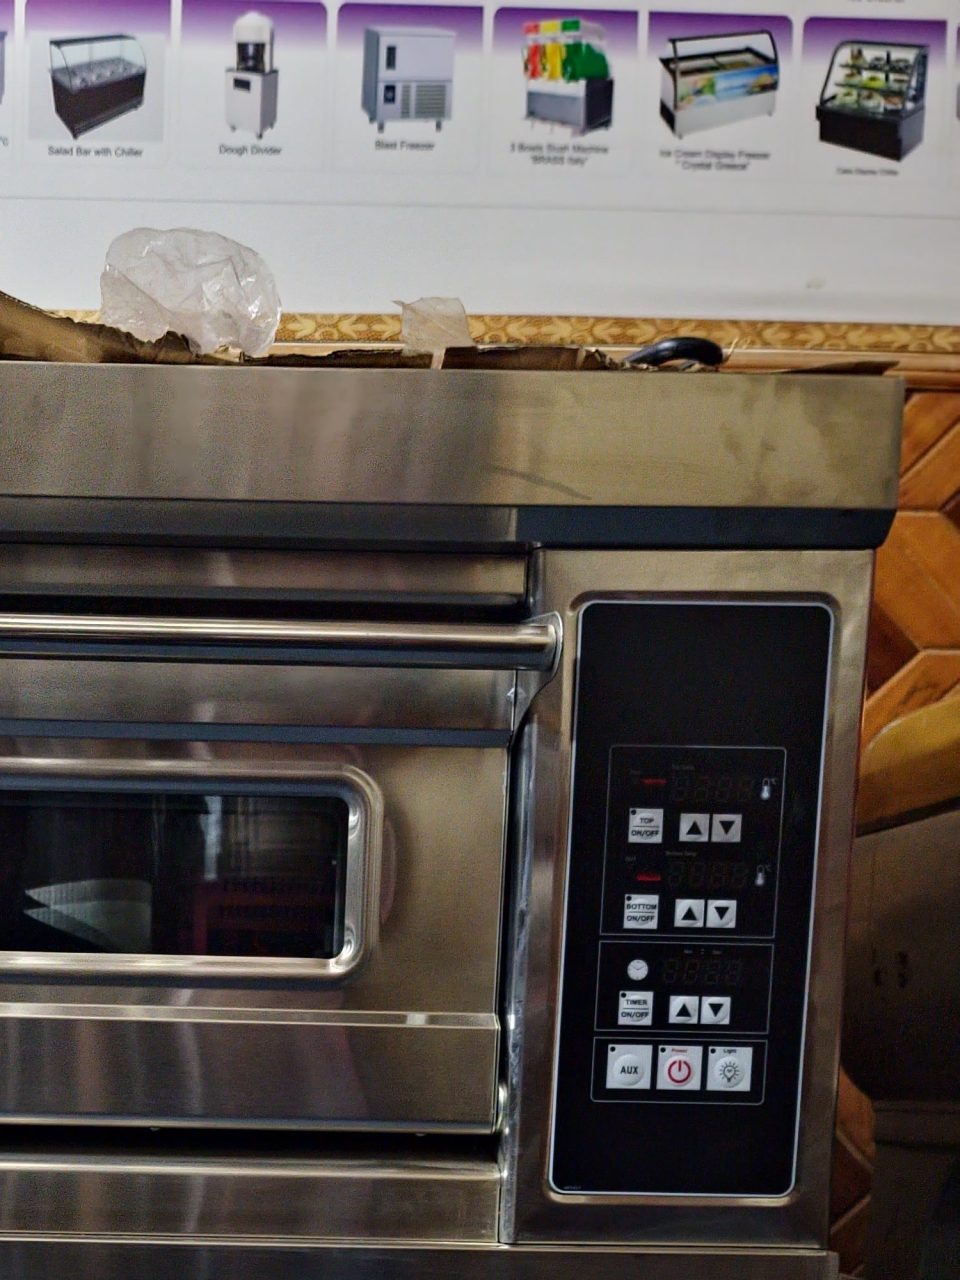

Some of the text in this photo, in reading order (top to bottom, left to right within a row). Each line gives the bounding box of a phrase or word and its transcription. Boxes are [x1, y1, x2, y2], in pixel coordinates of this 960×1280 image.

[48, 145, 143, 158] Salad Bar with Chiller
[219, 144, 282, 157] Dough Divider
[375, 140, 435, 151] Blast Freezer
[620, 1065, 639, 1075] AUX
